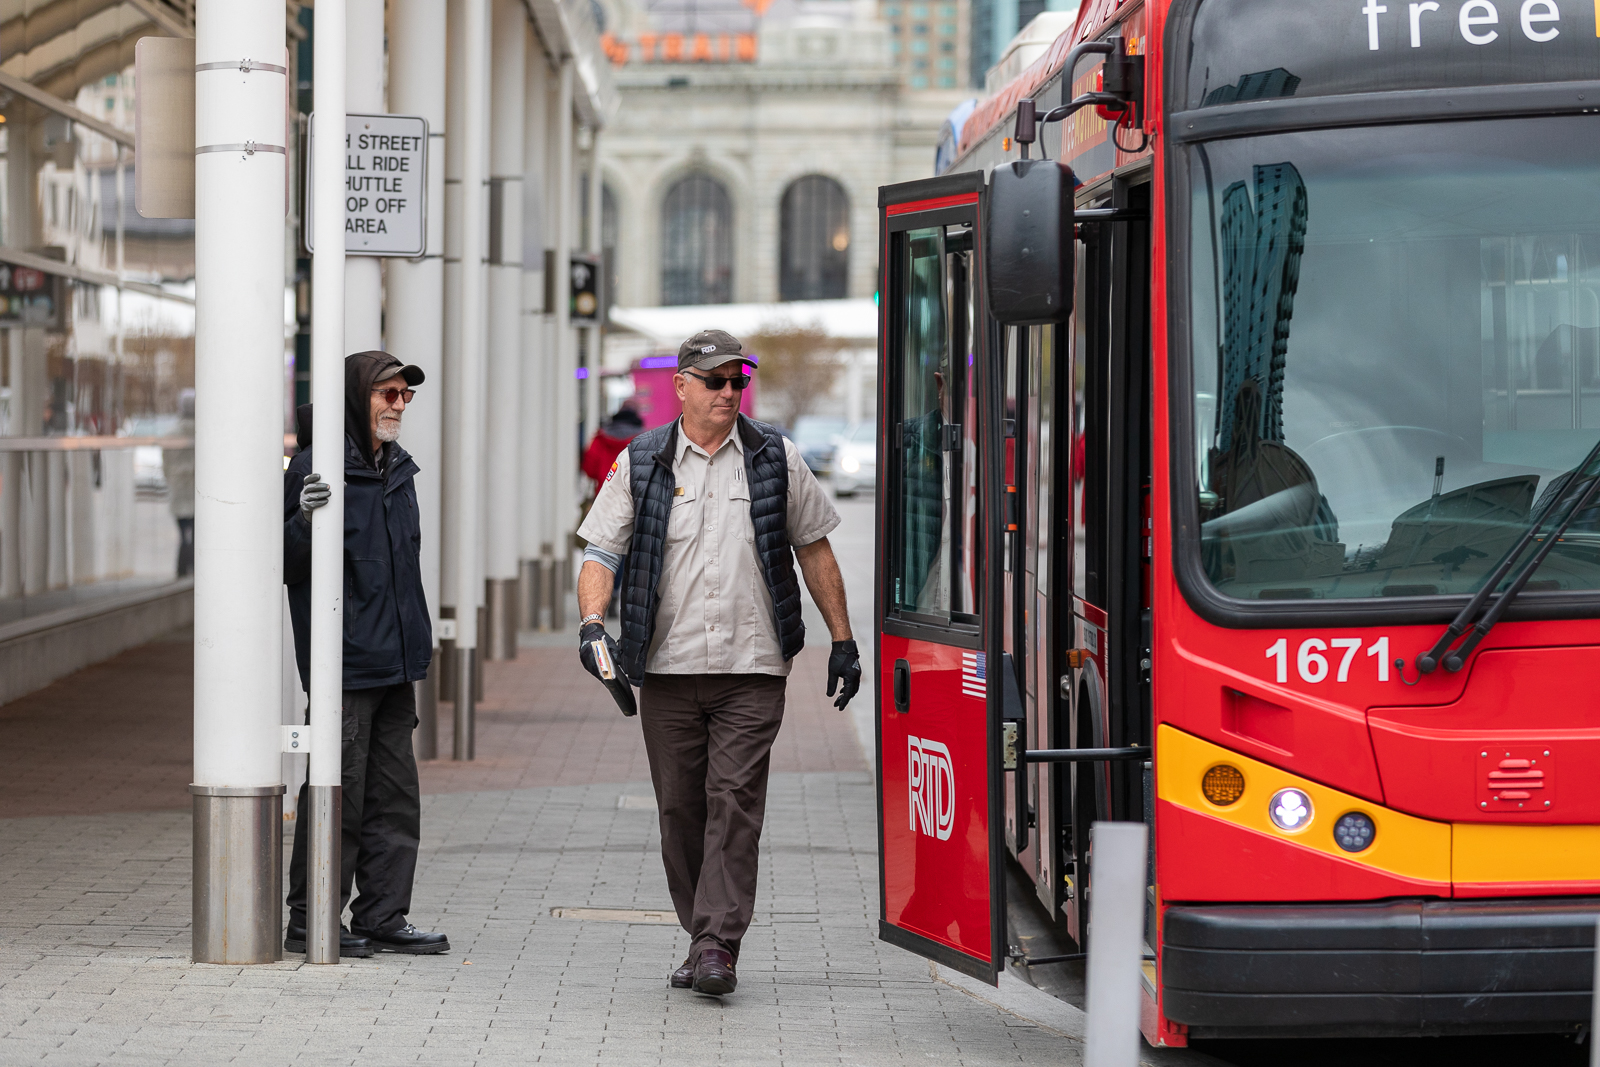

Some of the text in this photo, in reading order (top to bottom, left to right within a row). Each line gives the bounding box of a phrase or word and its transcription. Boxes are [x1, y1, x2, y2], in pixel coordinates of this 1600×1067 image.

[1362, 0, 1560, 50] free
[358, 133, 421, 152] STREET
[372, 156, 410, 172] RIDE
[346, 176, 403, 193] HUTTLE
[375, 197, 407, 214] OFF
[345, 217, 388, 234] AREA
[701, 344, 716, 354] RTD
[1265, 636, 1390, 683] 1671
[908, 734, 955, 841] RTD
